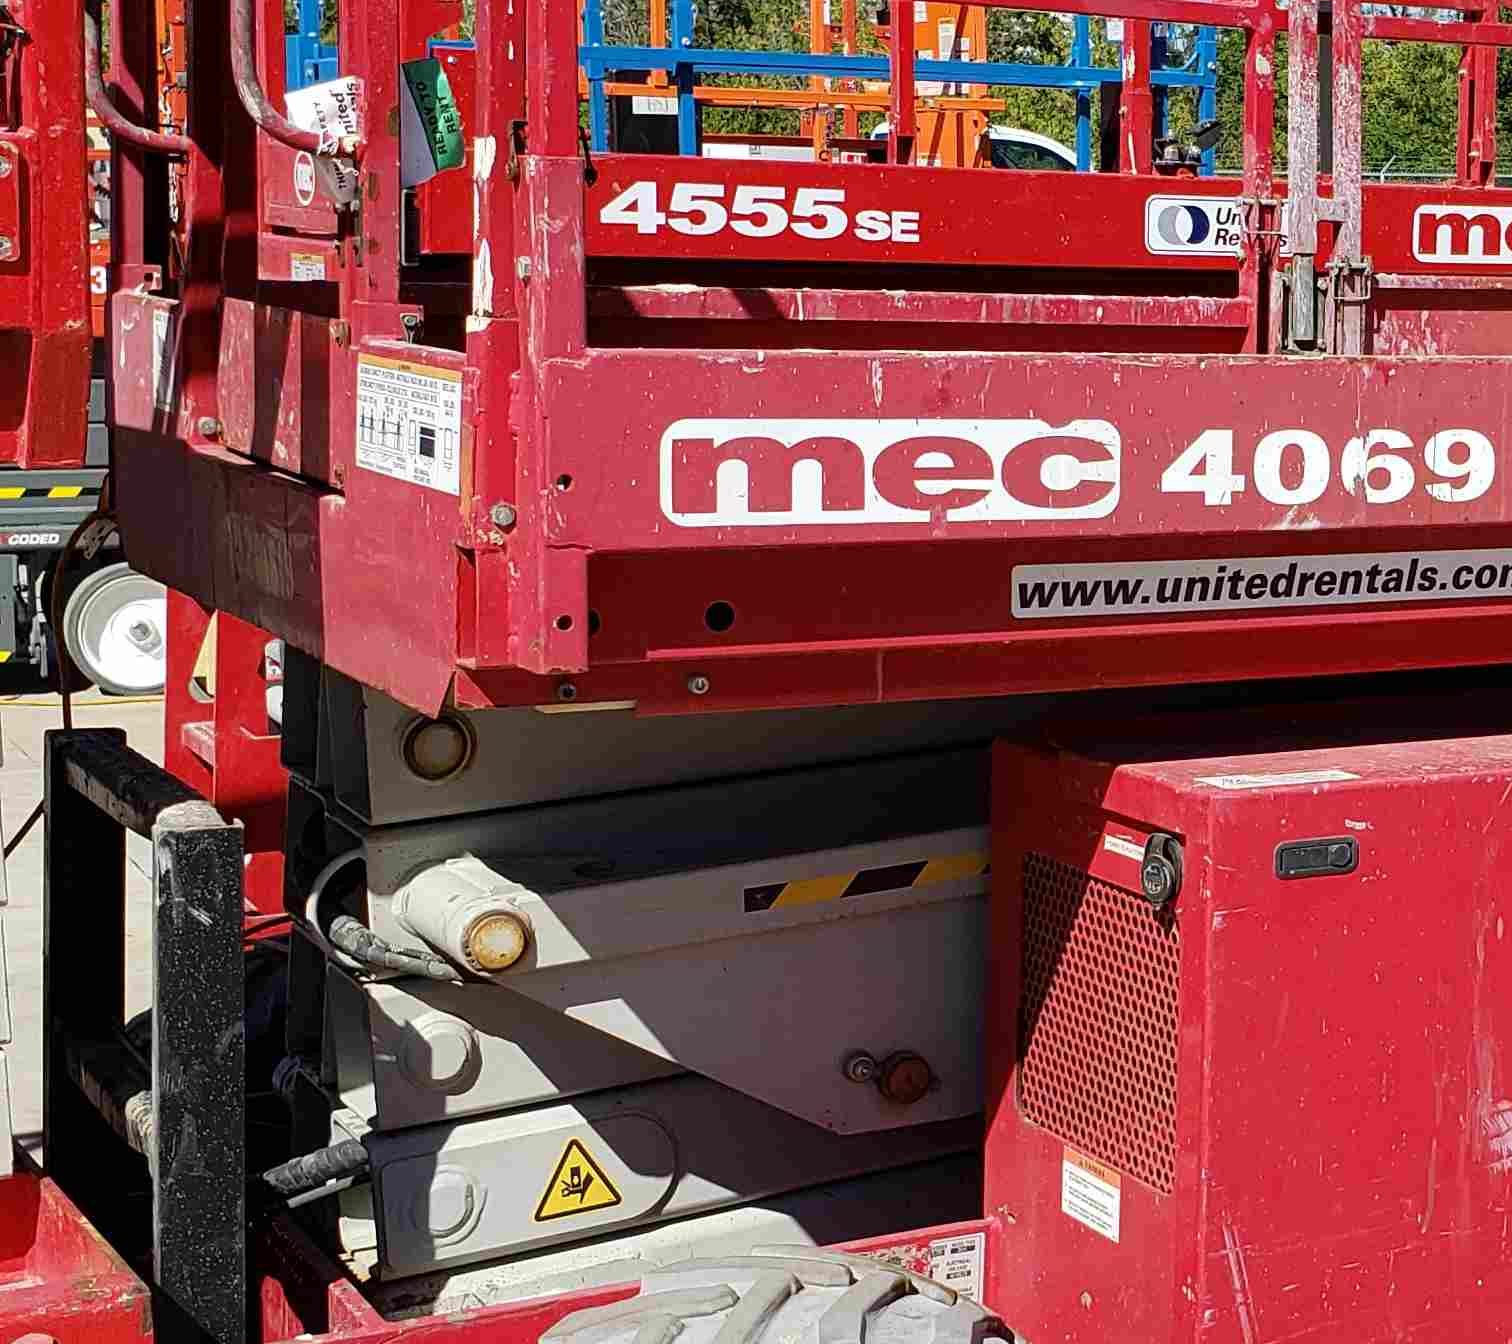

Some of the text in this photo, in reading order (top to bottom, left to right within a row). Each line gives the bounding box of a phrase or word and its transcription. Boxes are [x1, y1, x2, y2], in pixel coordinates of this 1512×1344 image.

[330, 90, 356, 136] nited
[415, 81, 448, 155] READY TO
[436, 96, 457, 134] RENT
[600, 181, 920, 243] 4555 SE
[671, 435, 1117, 514] mec
[1161, 429, 1496, 506] 4069
[8, 533, 60, 545] CODED
